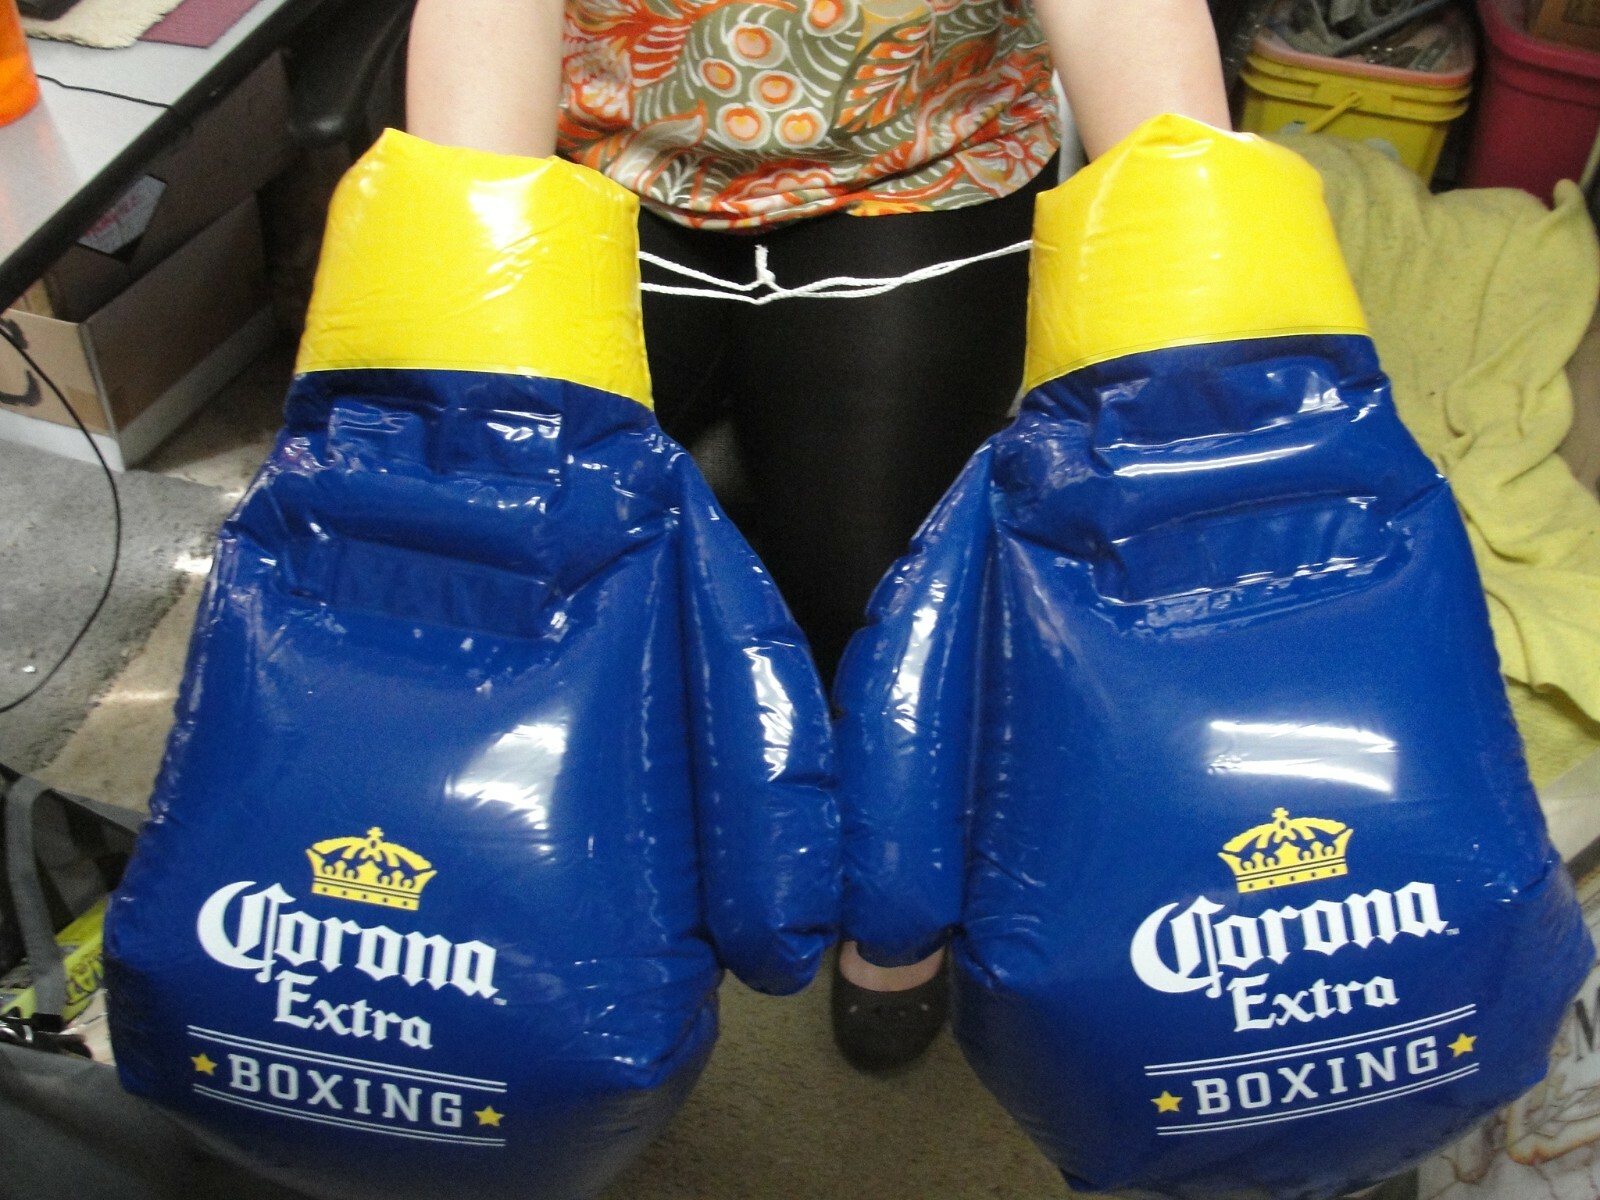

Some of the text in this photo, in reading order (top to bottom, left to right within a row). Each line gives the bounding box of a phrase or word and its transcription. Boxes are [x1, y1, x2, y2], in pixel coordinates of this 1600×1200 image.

[197, 881, 499, 998] Corona
[1130, 881, 1448, 998] Corona
[273, 970, 433, 1049] Extra
[1226, 973, 1399, 1032] Extra
[228, 1053, 462, 1127] BOXING
[1192, 1036, 1438, 1115] BOXING
